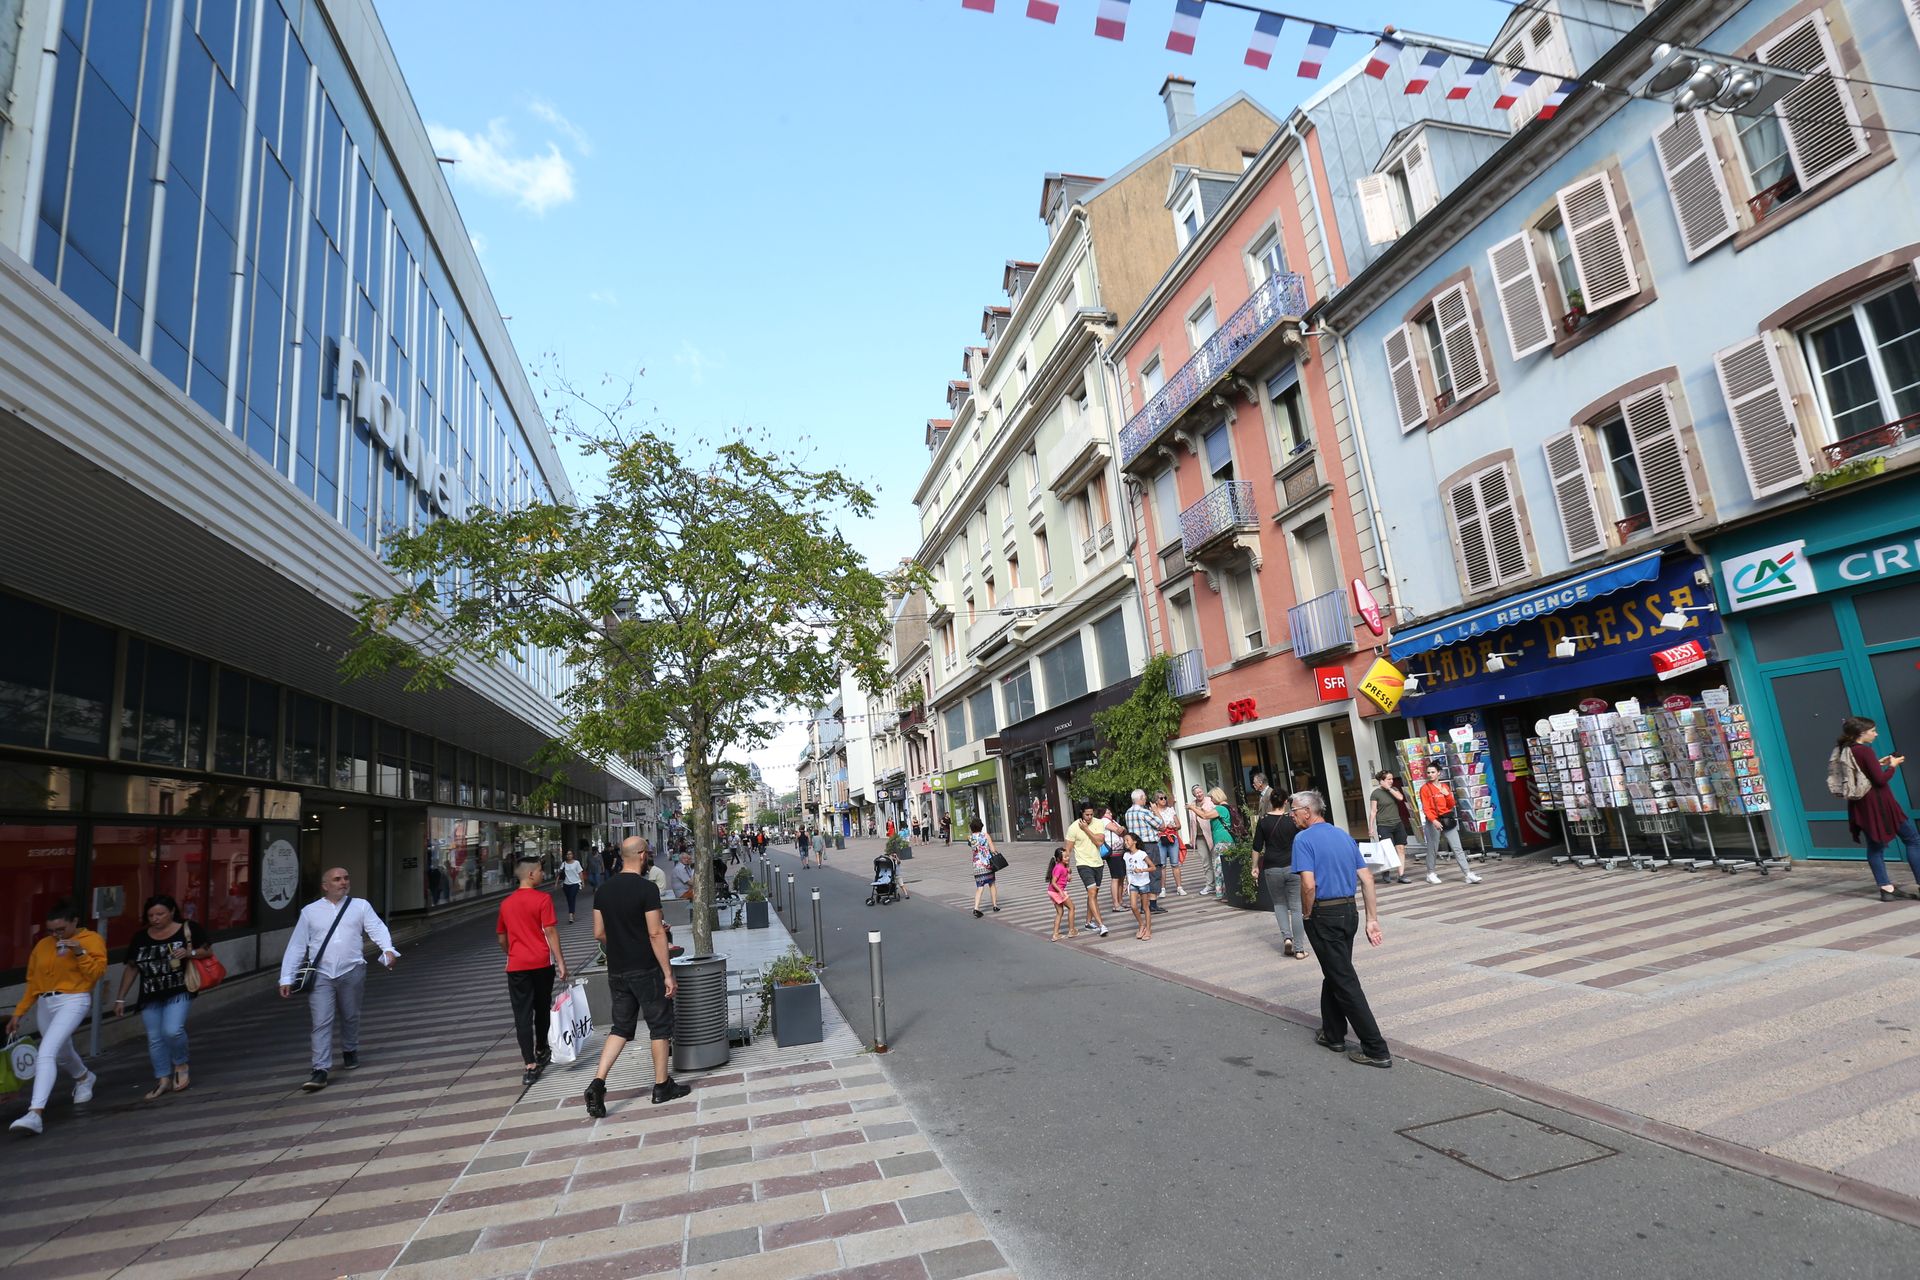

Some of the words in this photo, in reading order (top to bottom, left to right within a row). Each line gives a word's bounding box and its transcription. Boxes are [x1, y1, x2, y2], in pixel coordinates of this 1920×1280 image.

[1839, 539, 1920, 581] CR
[1434, 633, 1444, 645] A
[1459, 622, 1480, 637] LA
[1496, 584, 1589, 625] REGENCE
[1662, 643, 1698, 662] L'EST
[1324, 676, 1346, 690] SFR
[1365, 681, 1394, 709] PRESSE
[1228, 697, 1259, 724] SFR
[17, 1053, 34, 1072] 60
